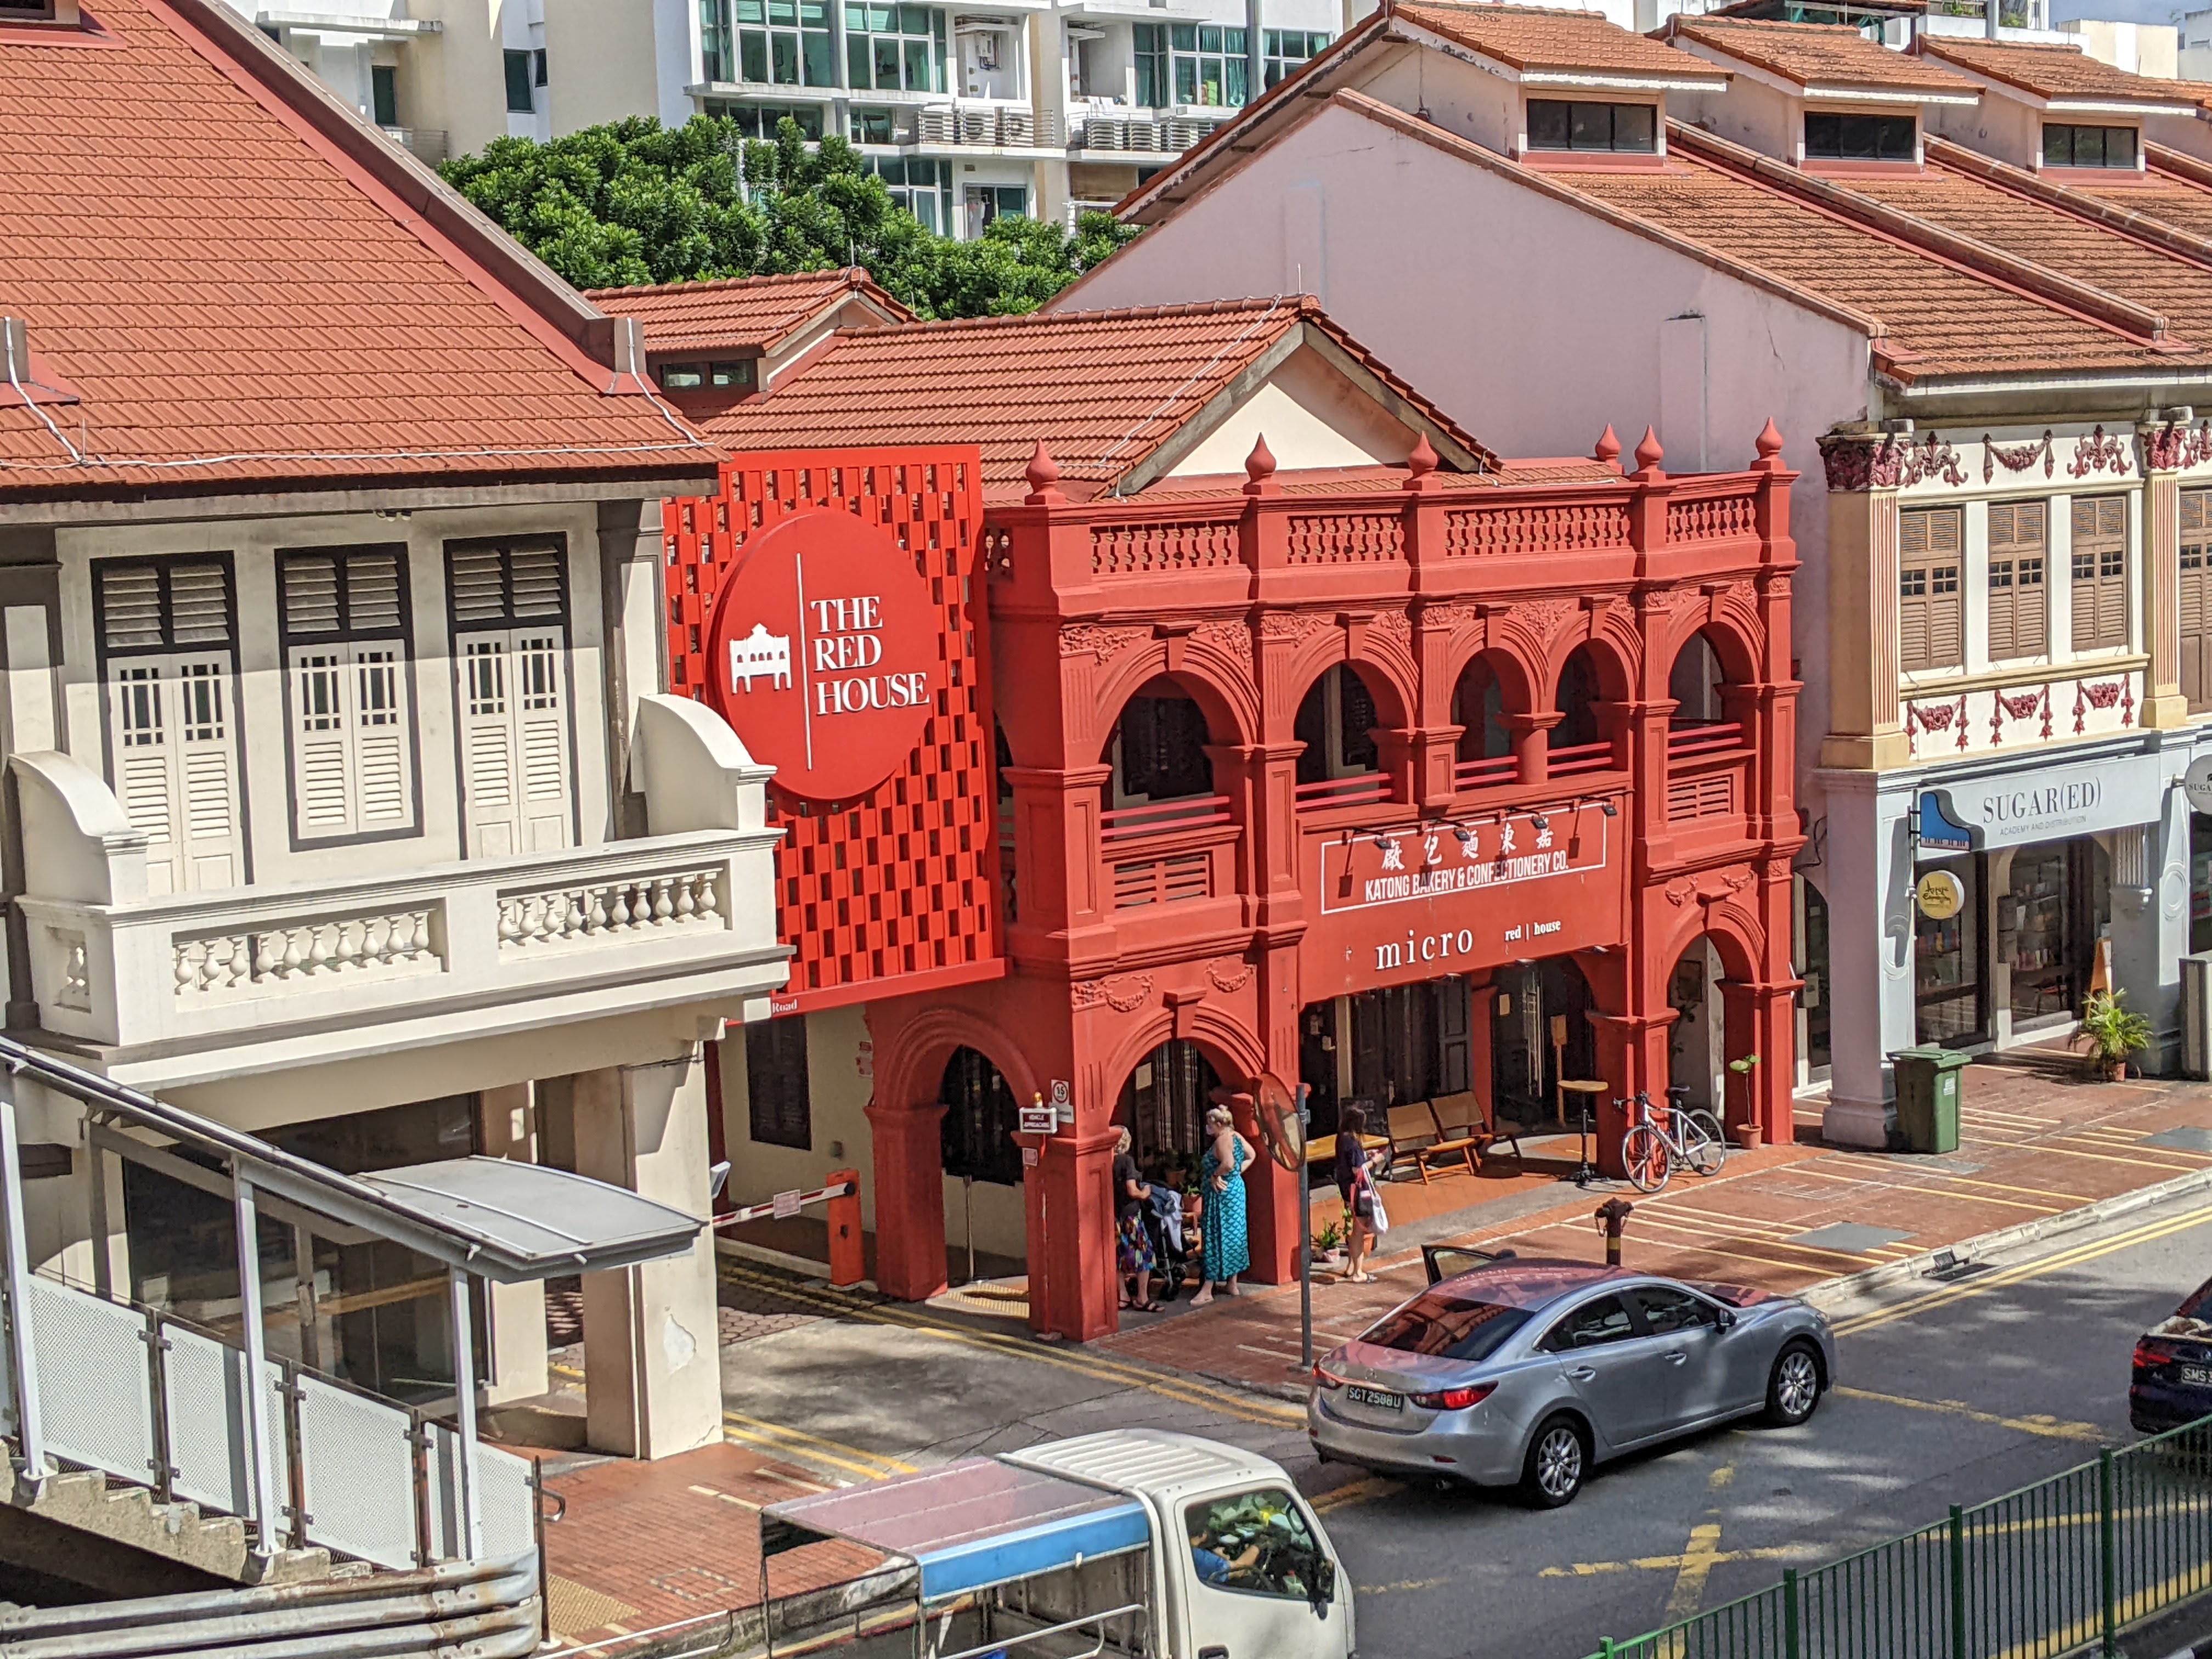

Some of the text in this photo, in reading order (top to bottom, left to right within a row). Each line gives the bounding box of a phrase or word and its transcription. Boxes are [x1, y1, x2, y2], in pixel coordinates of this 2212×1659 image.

[811, 596, 883, 633] THE
[814, 634, 882, 672] RED
[816, 672, 930, 715] HOUSE
[1983, 777, 2101, 823] SUGAR(ED)
[2000, 825, 2029, 836] ACADEMY
[2030, 822, 2044, 831] AND
[1365, 850, 1569, 901] KATONG BAKERY & CONFECTIONERY CO.
[1375, 929, 1473, 969] micro
[1505, 920, 1561, 941] red house
[772, 998, 797, 1014] Road
[1057, 1086, 1065, 1095] 15
